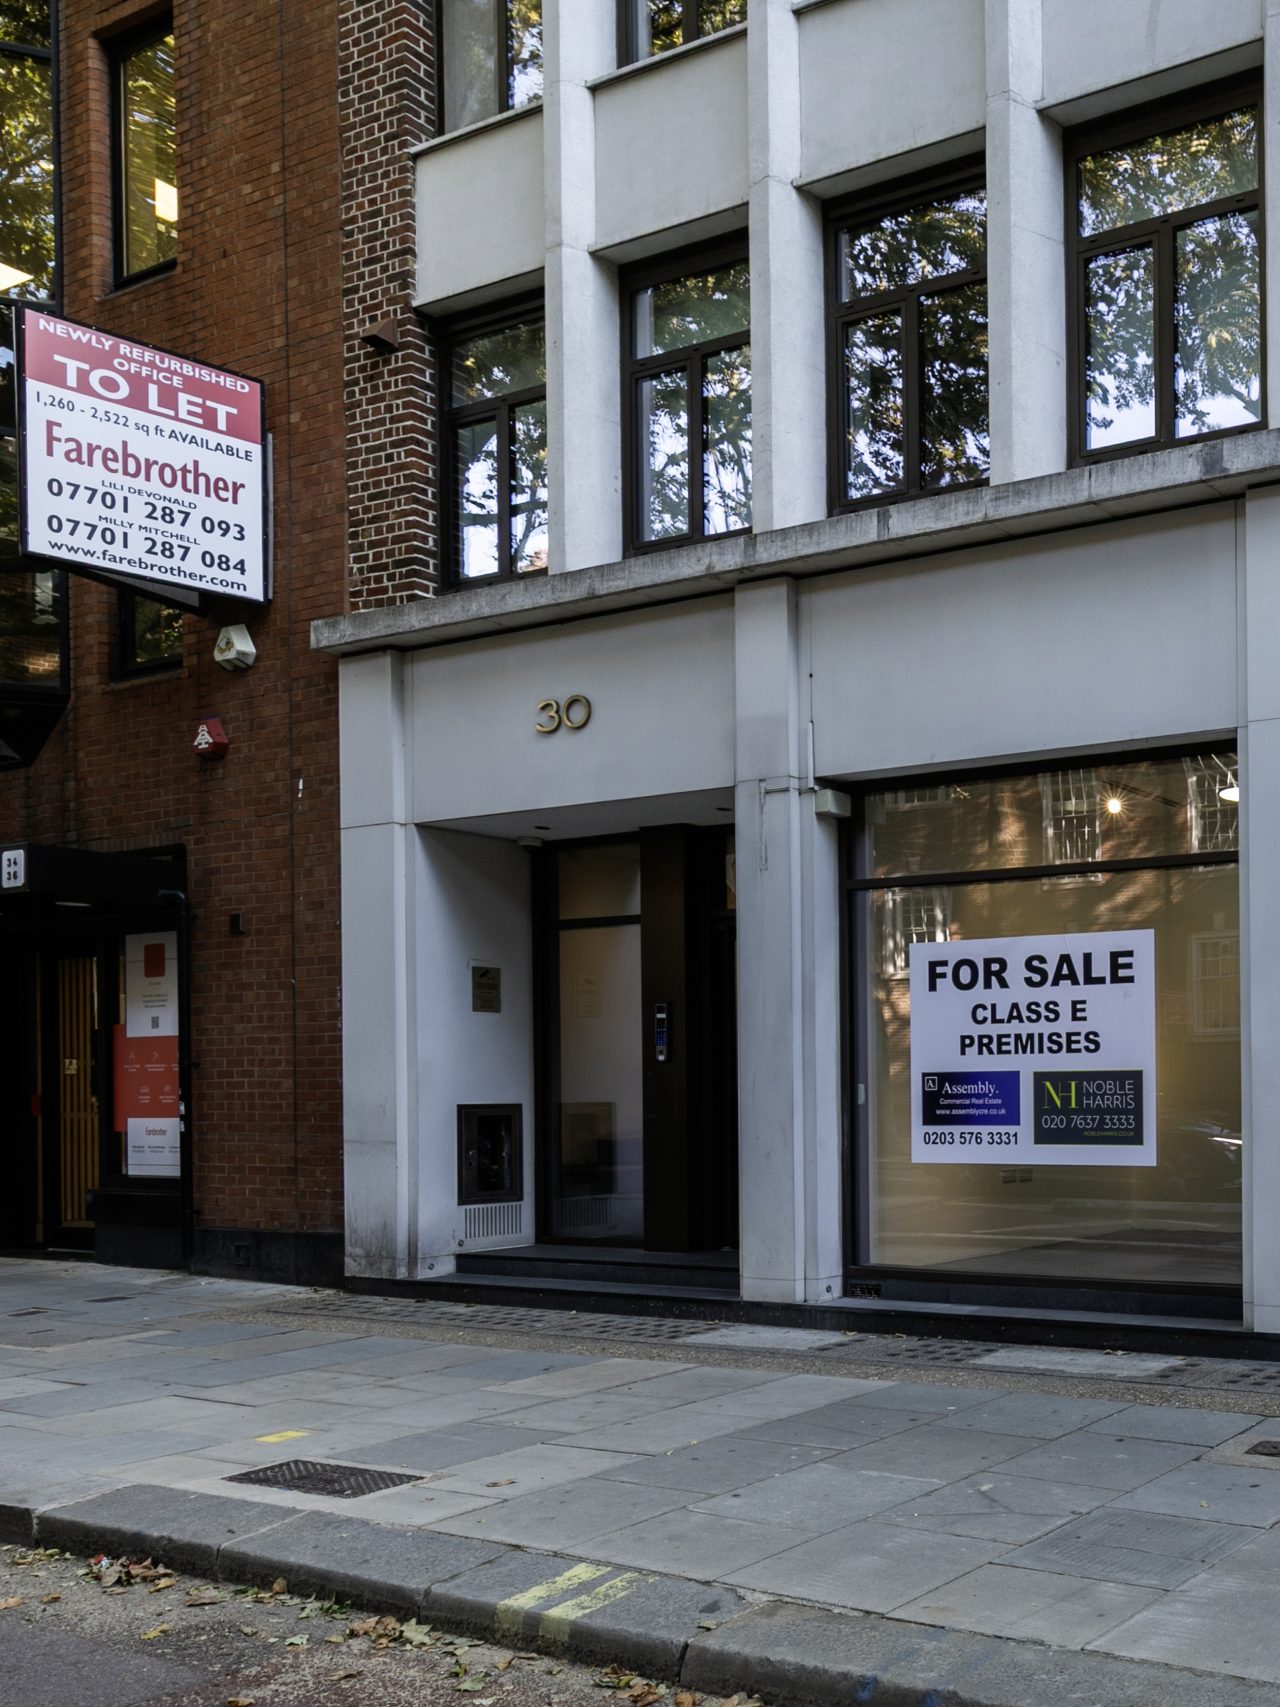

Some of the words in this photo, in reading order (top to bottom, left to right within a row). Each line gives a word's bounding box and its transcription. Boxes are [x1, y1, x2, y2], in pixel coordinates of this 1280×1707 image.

[38, 318, 115, 350] NEWLY
[119, 343, 250, 393] REFURBISHED
[113, 358, 184, 389] OFFICE
[53, 354, 130, 400] TO
[147, 383, 238, 432] LET
[36, 391, 75, 412] 1,260
[90, 407, 130, 428] 2,522
[134, 422, 150, 437] sq
[154, 425, 165, 438] ft
[168, 430, 253, 462] AVAILABLE
[46, 419, 246, 505] Farebrother
[47, 478, 129, 513] 07701
[144, 501, 191, 527] 287
[200, 516, 246, 541] 093
[101, 480, 124, 491] LILI
[128, 486, 197, 510] DEVONALD
[47, 514, 129, 549] 07701
[144, 536, 191, 562] 287
[200, 550, 247, 576] 084
[98, 515, 135, 529] MILLY
[138, 524, 200, 546] MITCHELL
[48, 540, 247, 592] www.farebrother.com
[535, 695, 592, 734] 30
[6, 857, 18, 867] 34
[6, 870, 18, 881] 36
[928, 956, 1010, 992] FOR
[1023, 950, 1135, 989] SALE
[971, 1000, 1060, 1025] CLASS
[1071, 1000, 1088, 1022] E
[960, 1030, 1101, 1056] PREMISES
[942, 1081, 999, 1097] Assembly.
[984, 1097, 1002, 1105] Estate
[1083, 1080, 1135, 1094] NOBLE
[1083, 1095, 1135, 1109] HARRIS
[1041, 1115, 1066, 1128] 020
[1070, 1115, 1100, 1128] 7637
[1103, 1115, 1135, 1128] 3333
[923, 1131, 955, 1145] 0203
[959, 1131, 983, 1145] 576
[987, 1131, 1018, 1145] 3331
